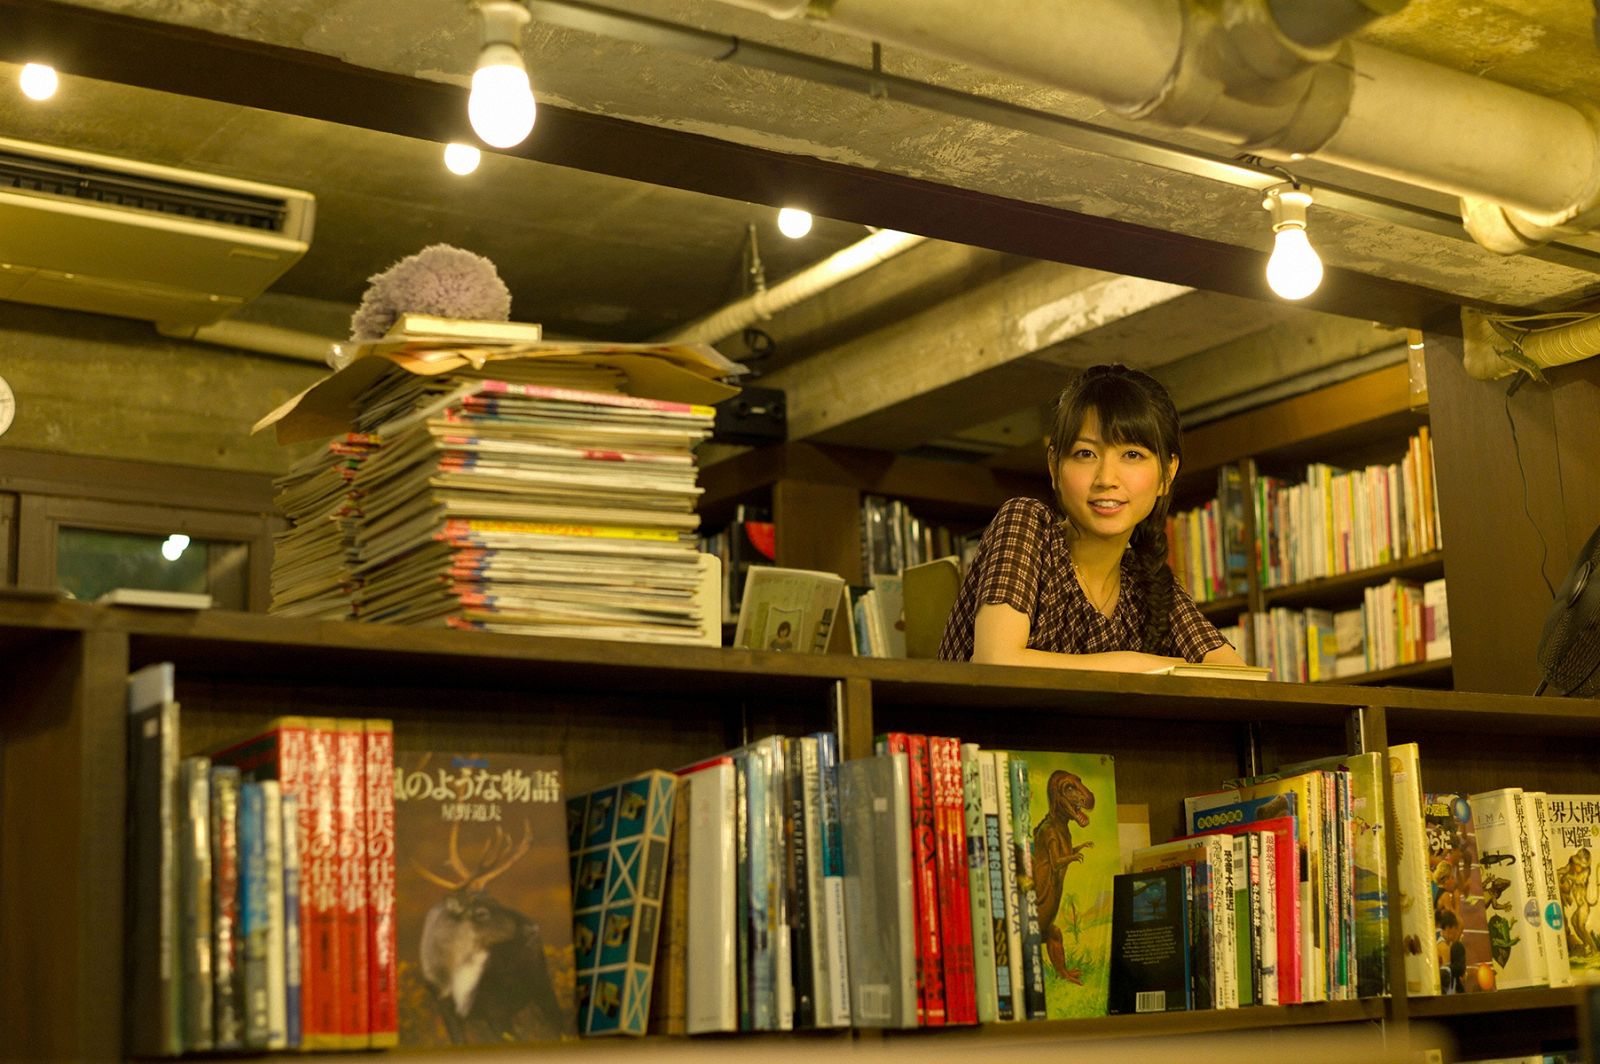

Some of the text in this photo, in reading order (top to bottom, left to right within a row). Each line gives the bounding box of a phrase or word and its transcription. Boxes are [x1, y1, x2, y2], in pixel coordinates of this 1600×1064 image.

[441, 803, 502, 822] 星野道夫
[1549, 801, 1600, 824] 界大博
[1424, 827, 1453, 851] らだ
[1561, 826, 1592, 848] 図鑑
